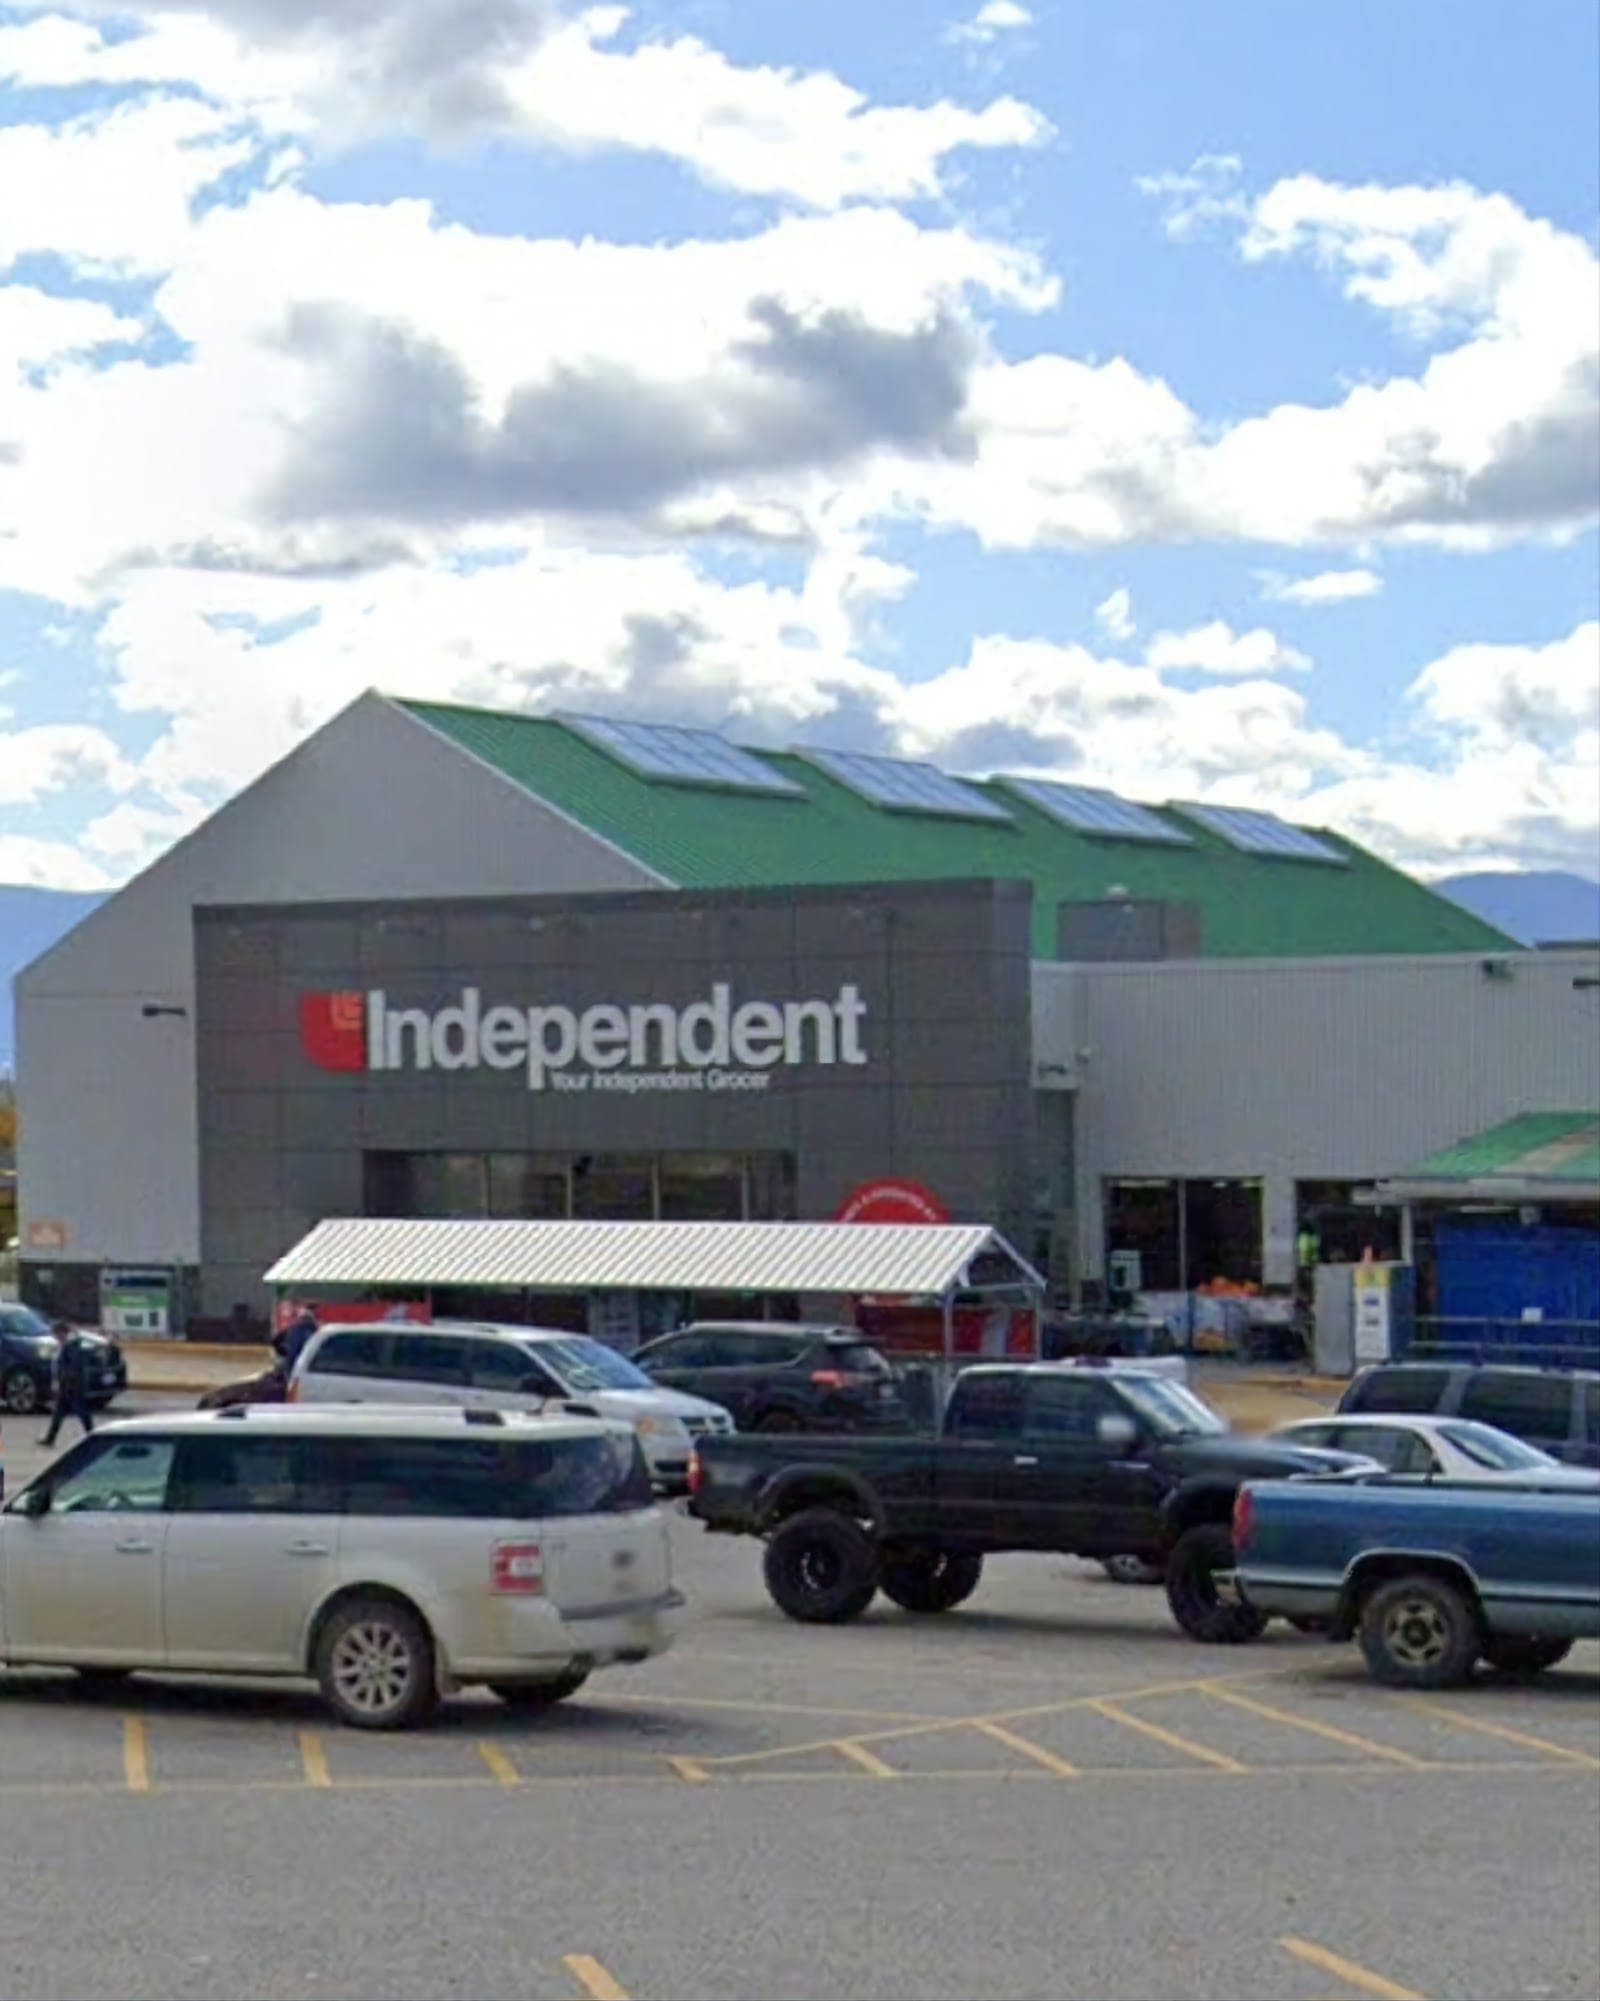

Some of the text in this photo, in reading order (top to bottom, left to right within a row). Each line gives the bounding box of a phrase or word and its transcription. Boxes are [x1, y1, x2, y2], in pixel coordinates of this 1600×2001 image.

[367, 983, 867, 1090] Independent
[552, 1069, 771, 1093] Your Independent Grocer
